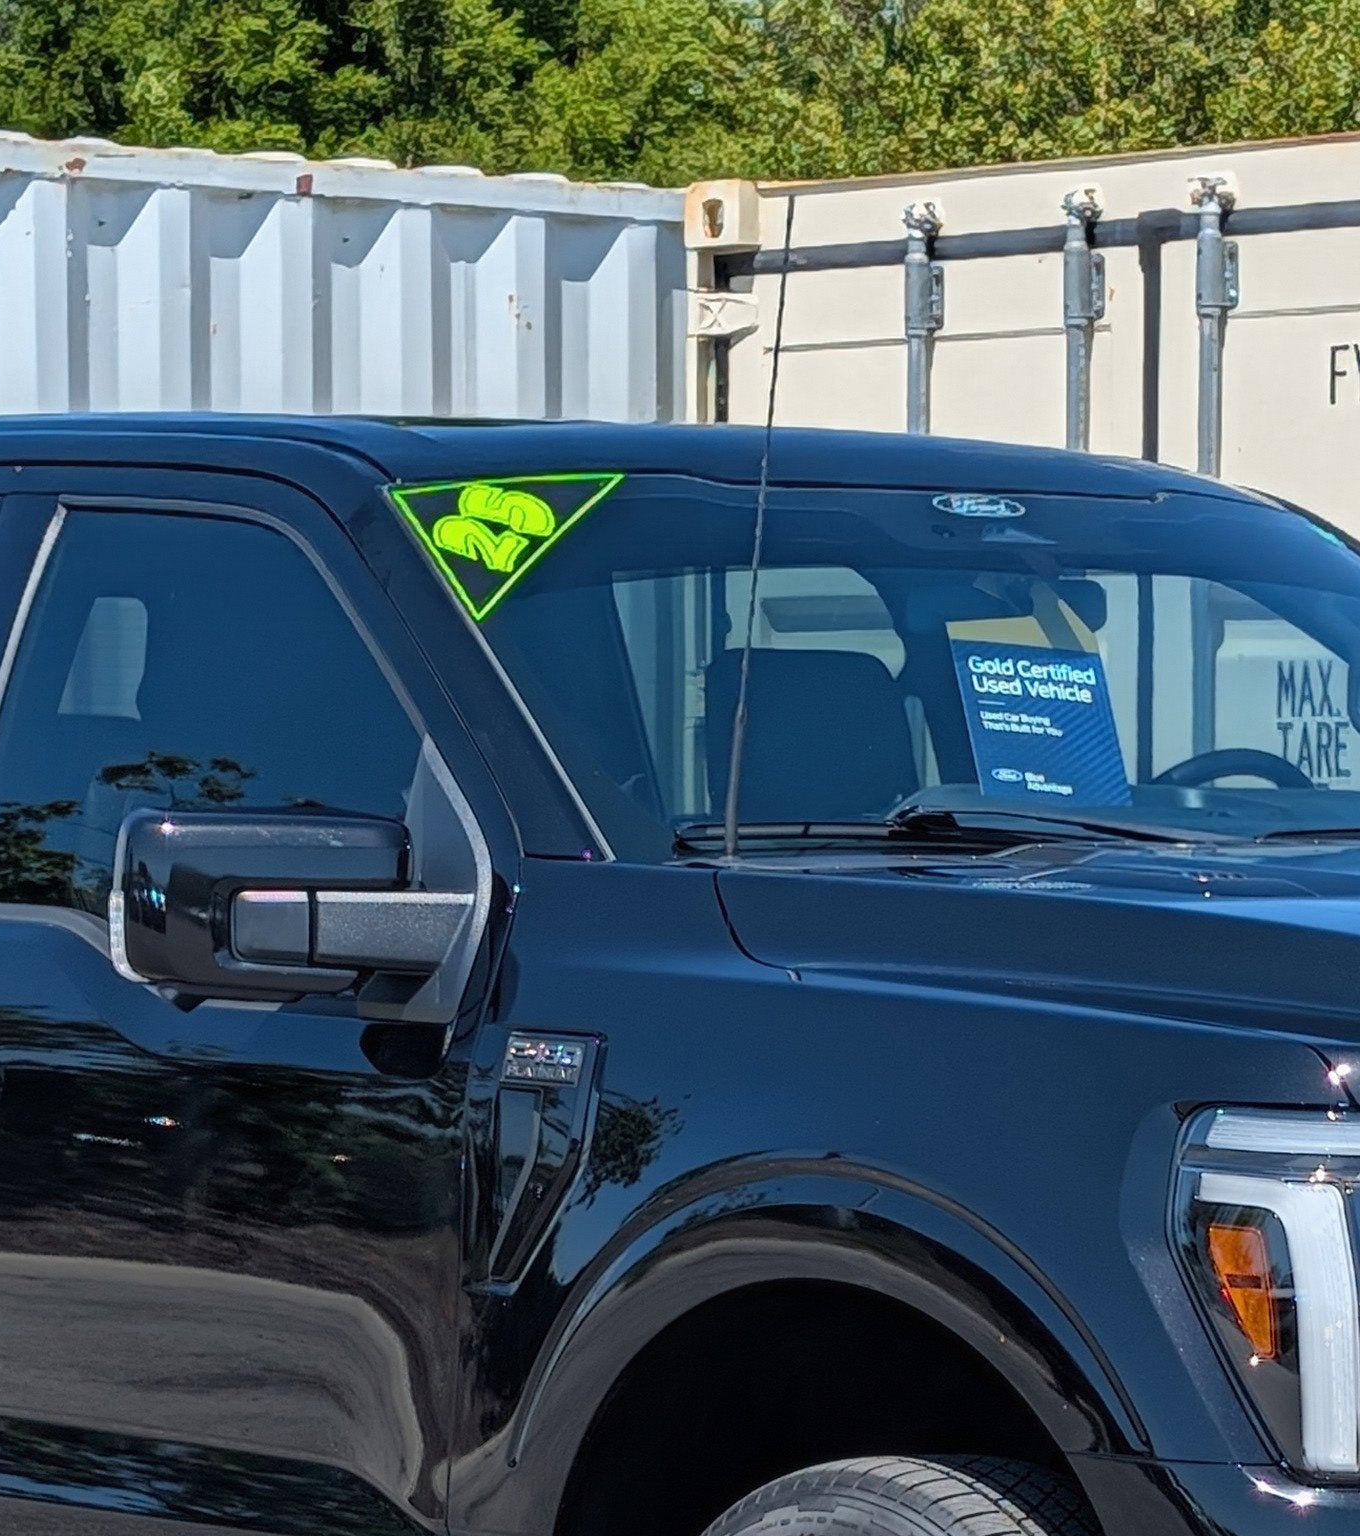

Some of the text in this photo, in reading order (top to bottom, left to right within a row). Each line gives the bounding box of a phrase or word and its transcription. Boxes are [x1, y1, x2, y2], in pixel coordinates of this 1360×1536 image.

[968, 655, 1096, 686] Gold Certified
[972, 675, 1093, 703] Used Vehicle
[1277, 721, 1351, 778] TARE
